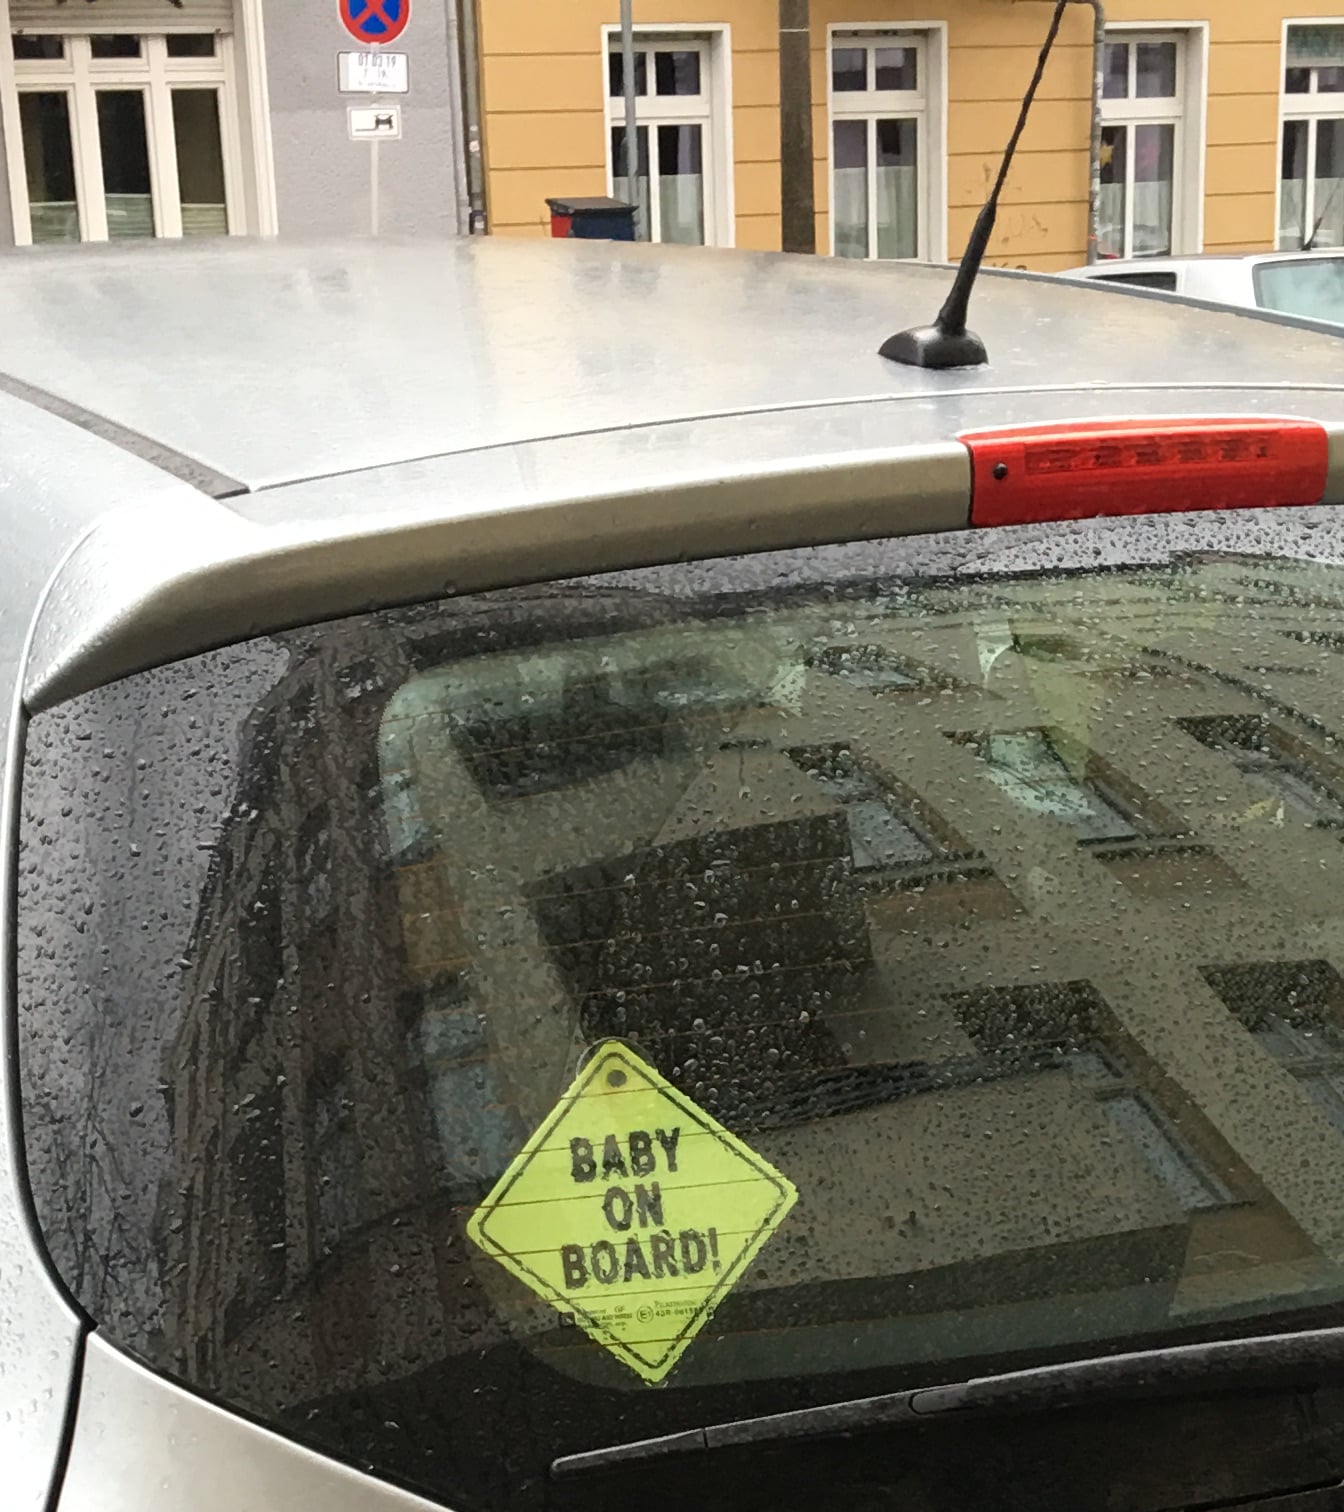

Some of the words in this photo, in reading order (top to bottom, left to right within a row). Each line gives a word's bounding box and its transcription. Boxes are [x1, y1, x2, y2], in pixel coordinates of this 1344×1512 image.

[569, 1127, 681, 1183] BABY
[602, 1181, 665, 1232] ON
[561, 1227, 722, 1290] BOARD!
